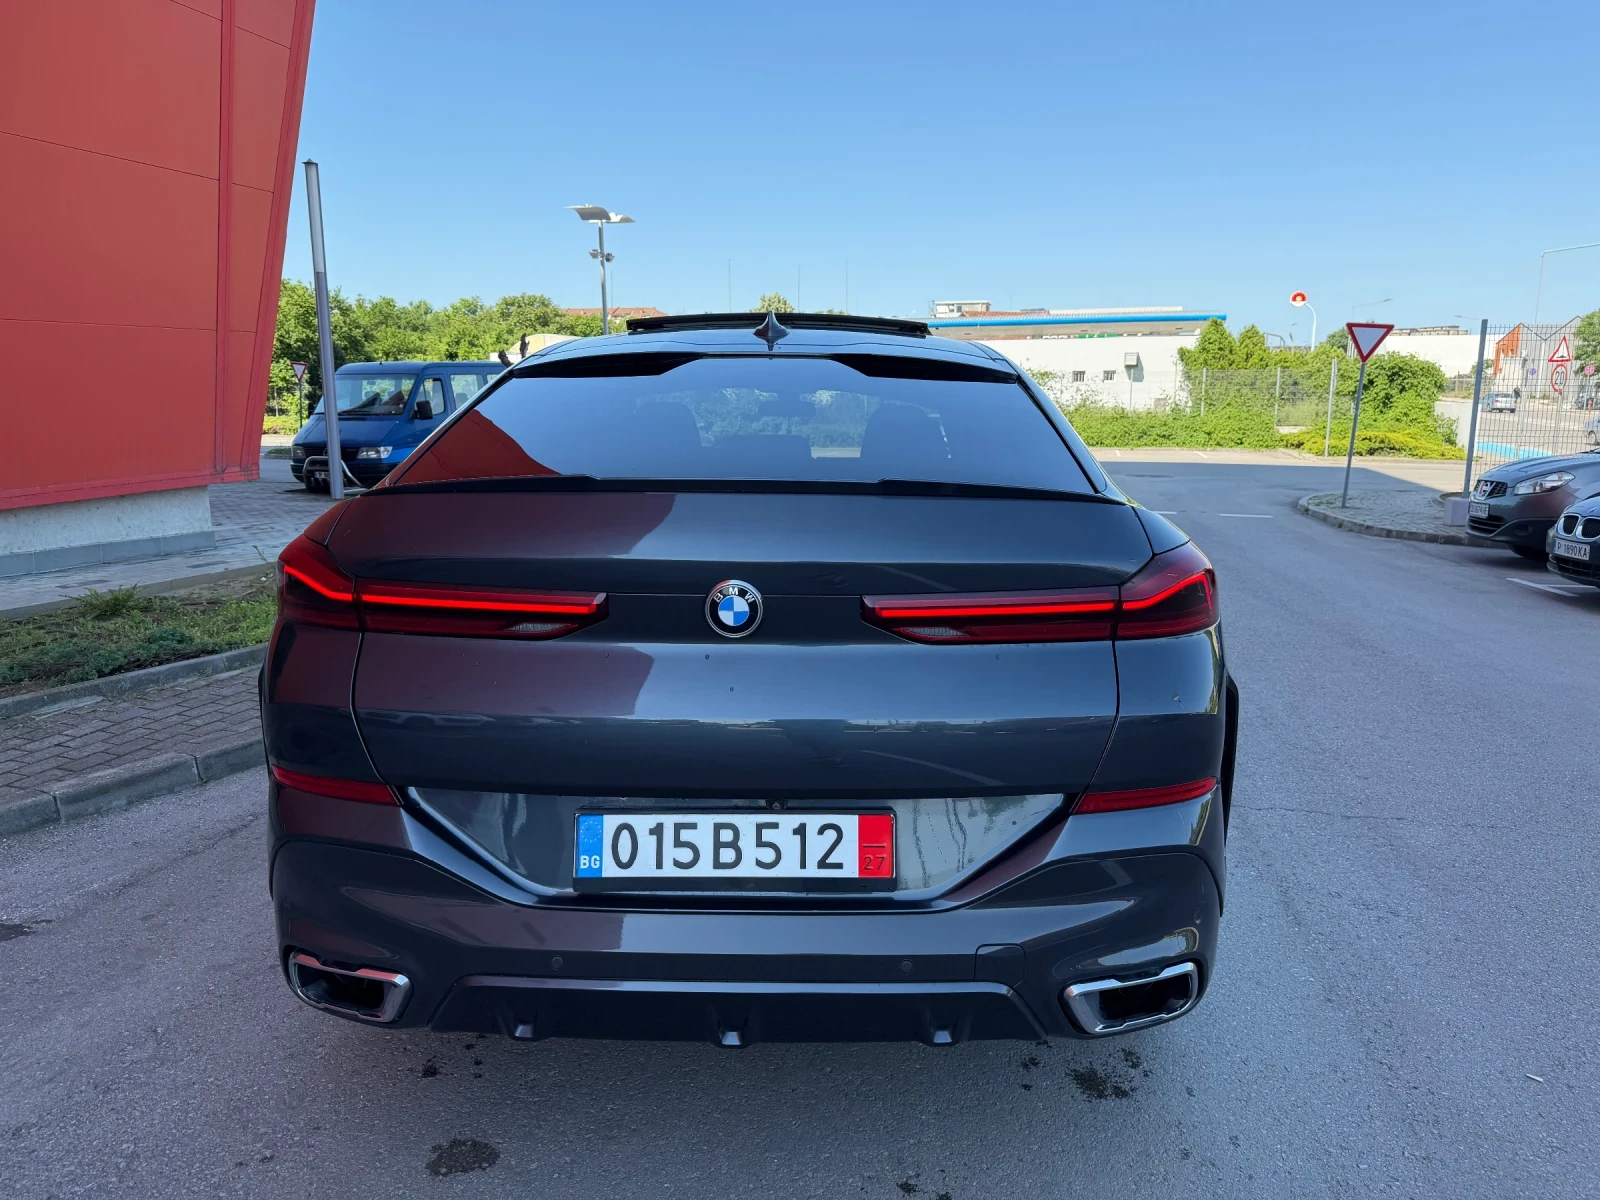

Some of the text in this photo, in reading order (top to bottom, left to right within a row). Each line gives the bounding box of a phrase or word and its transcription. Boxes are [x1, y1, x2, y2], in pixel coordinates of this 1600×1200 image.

[1554, 371, 1565, 385] 20
[713, 587, 755, 603] BMW
[611, 822, 844, 870] 015B512
[579, 855, 601, 869] BG
[863, 854, 886, 871] 27
